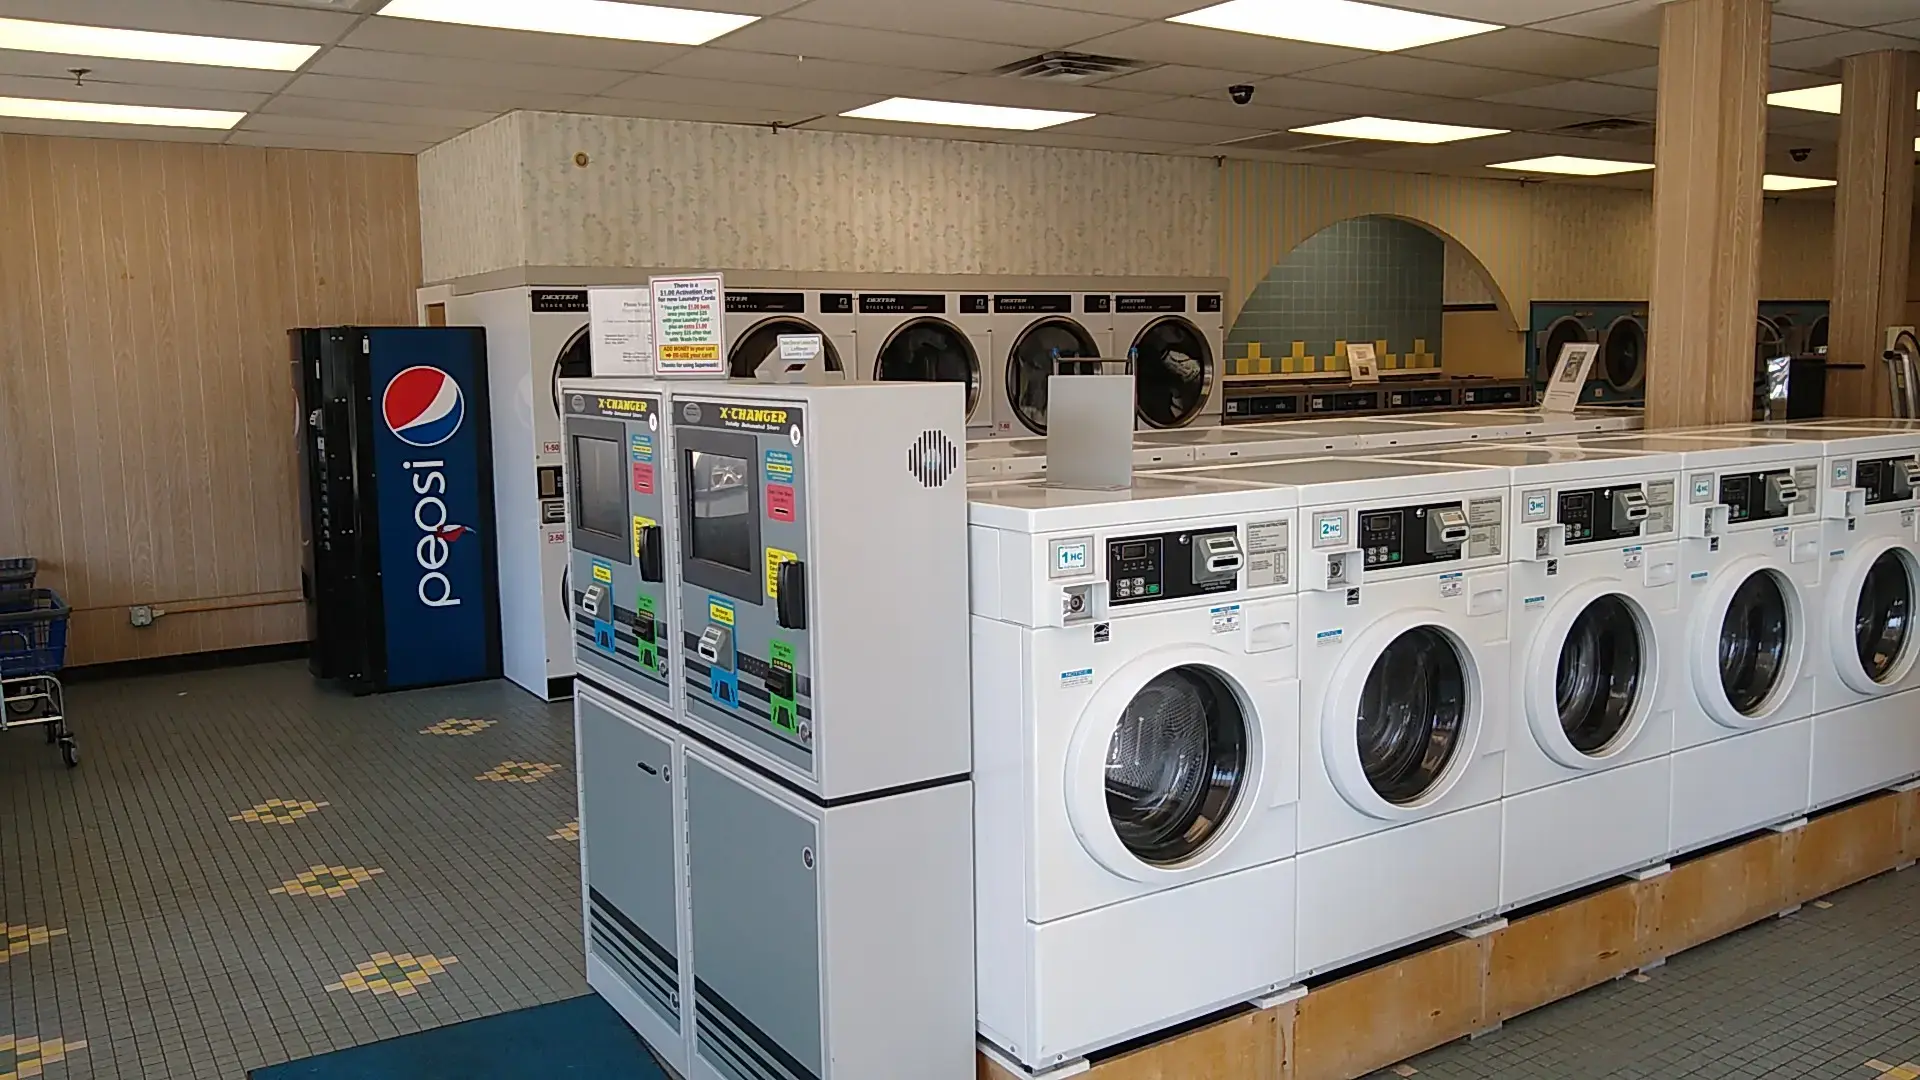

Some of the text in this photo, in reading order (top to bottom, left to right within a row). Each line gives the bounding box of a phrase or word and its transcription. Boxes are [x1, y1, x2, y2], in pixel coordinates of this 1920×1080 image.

[598, 398, 648, 412] X-CHANGER
[720, 406, 788, 424] X-CHANGER
[1696, 484, 1701, 492] 4
[1530, 501, 1536, 511] 3
[403, 460, 468, 607] pepsi
[1322, 524, 1330, 534] 2
[1062, 552, 1082, 564] 1 HC
